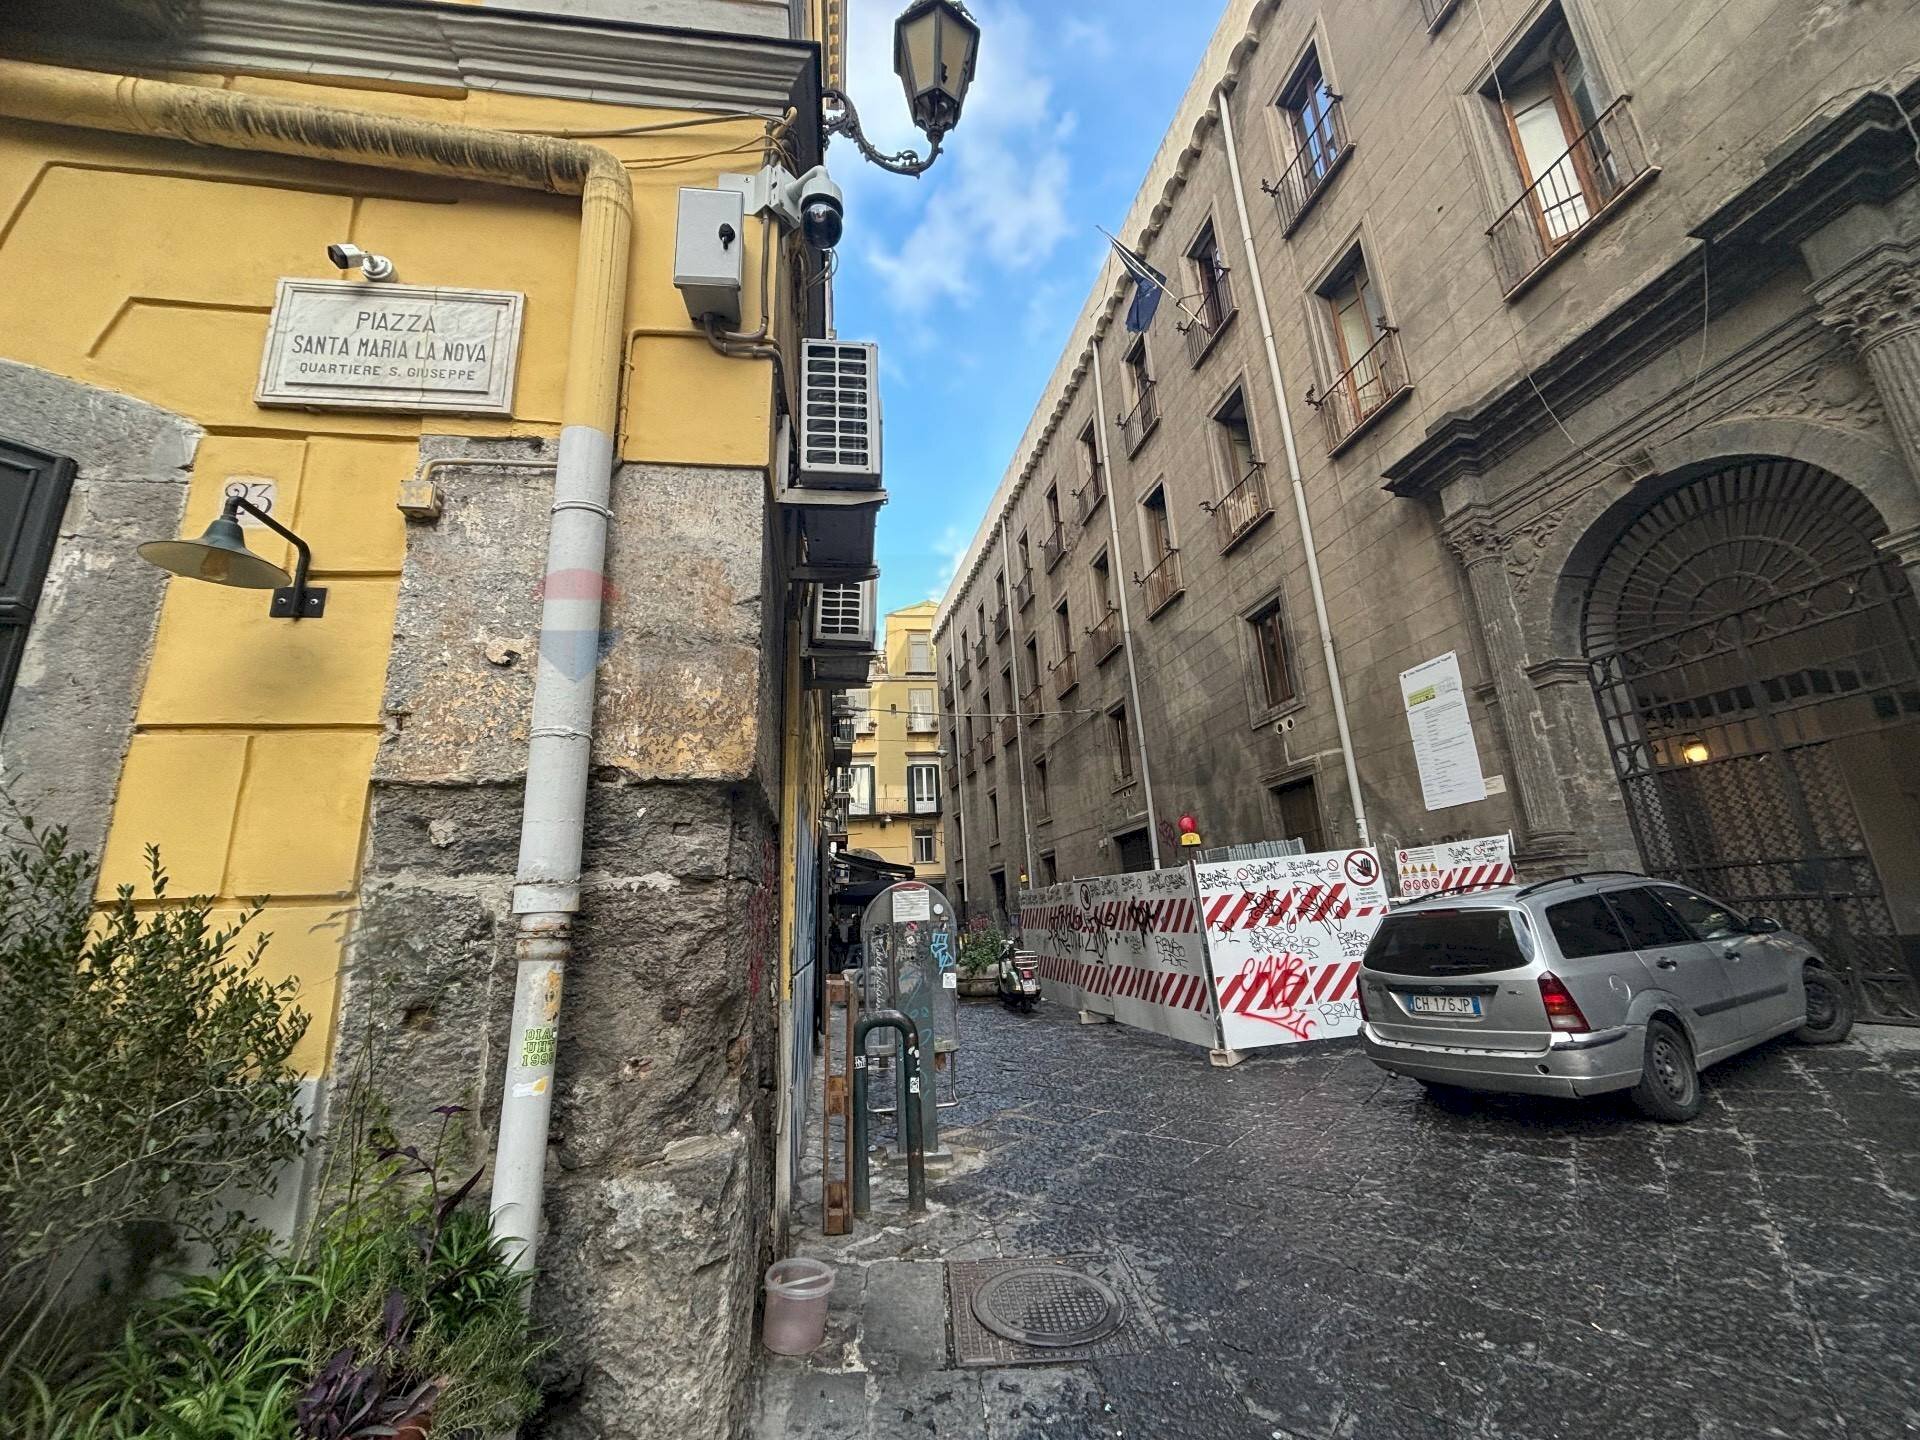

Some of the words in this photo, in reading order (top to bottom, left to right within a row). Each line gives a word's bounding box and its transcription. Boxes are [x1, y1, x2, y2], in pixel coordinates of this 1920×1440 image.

[356, 311, 436, 334] PIAZZA
[292, 335, 350, 356] SANTA
[357, 339, 408, 359] MARIA
[415, 341, 436, 361] LA
[443, 343, 487, 363] NOVA
[299, 362, 381, 376] QUARTIERE
[389, 367, 402, 378] S.
[407, 367, 476, 380] GIUSEPPE
[1415, 997, 1430, 1010] CH
